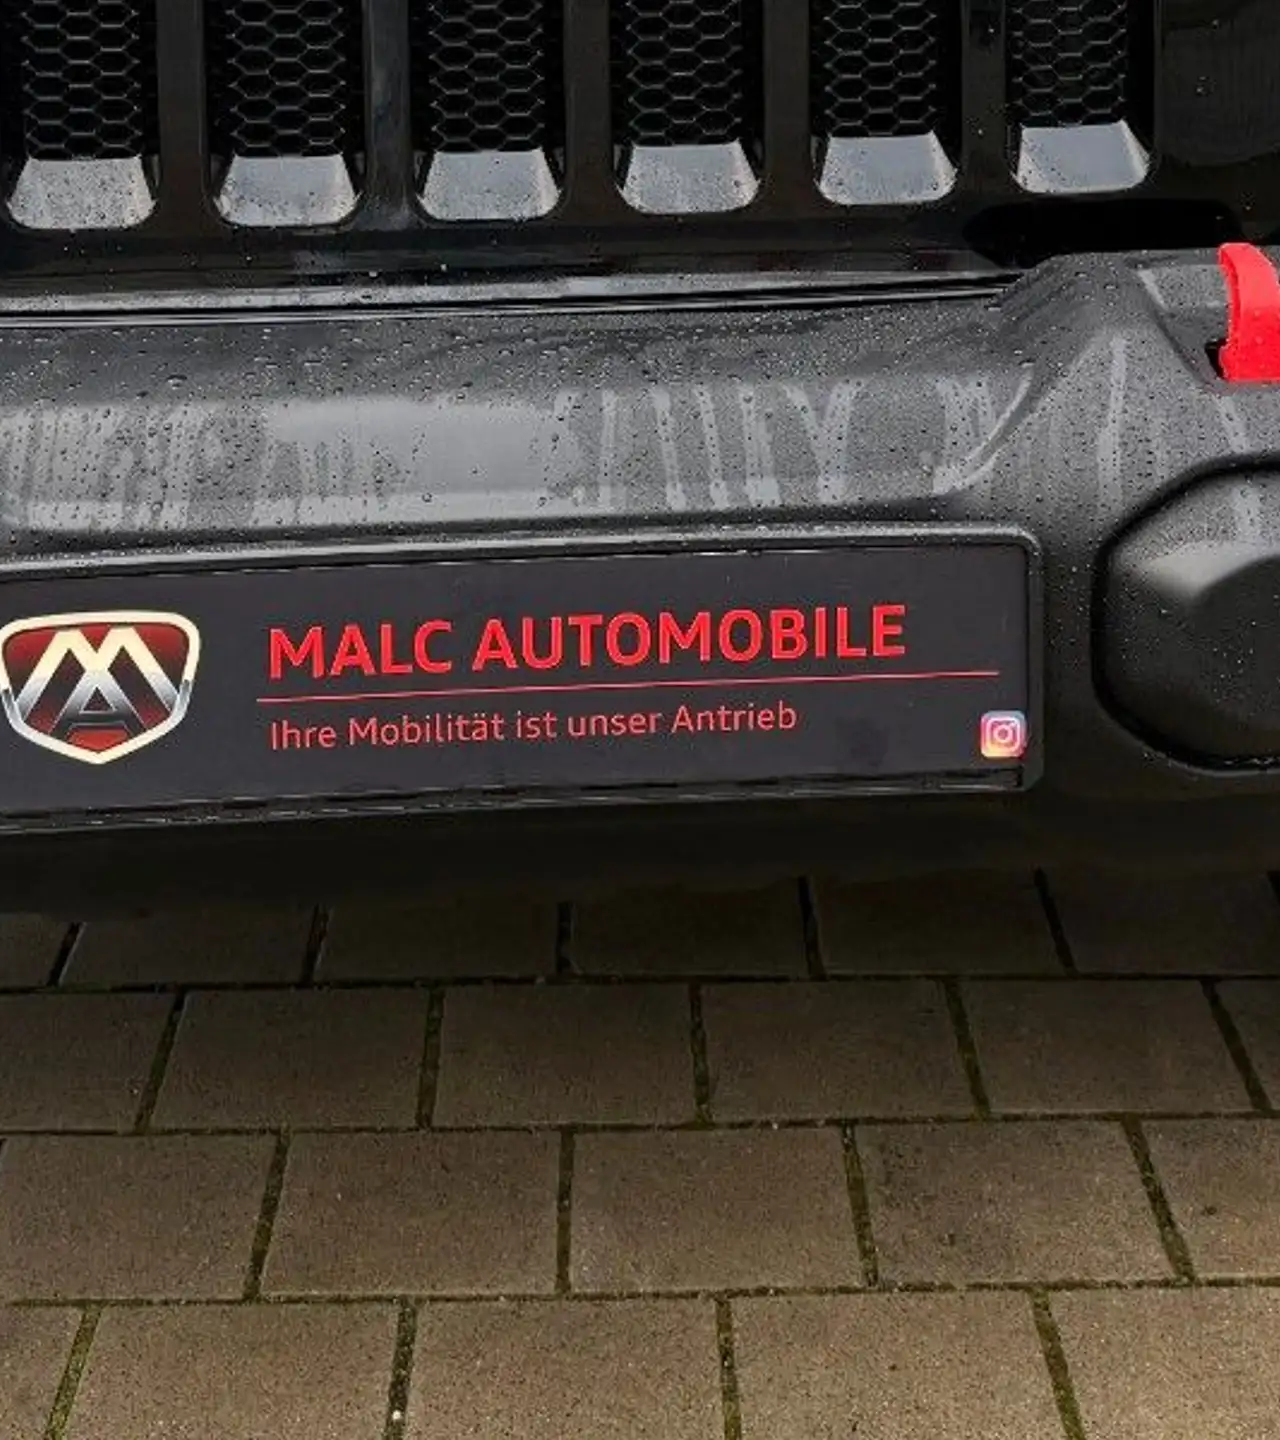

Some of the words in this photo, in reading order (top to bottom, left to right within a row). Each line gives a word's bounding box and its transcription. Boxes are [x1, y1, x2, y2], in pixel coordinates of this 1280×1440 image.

[269, 618, 453, 679] MALC
[472, 604, 906, 671] AUTOMOBILE
[271, 720, 337, 750] Ihre
[349, 713, 505, 745] Mobilität
[516, 711, 557, 739] ist
[567, 712, 662, 737] unser
[671, 700, 797, 734] Antrieb
